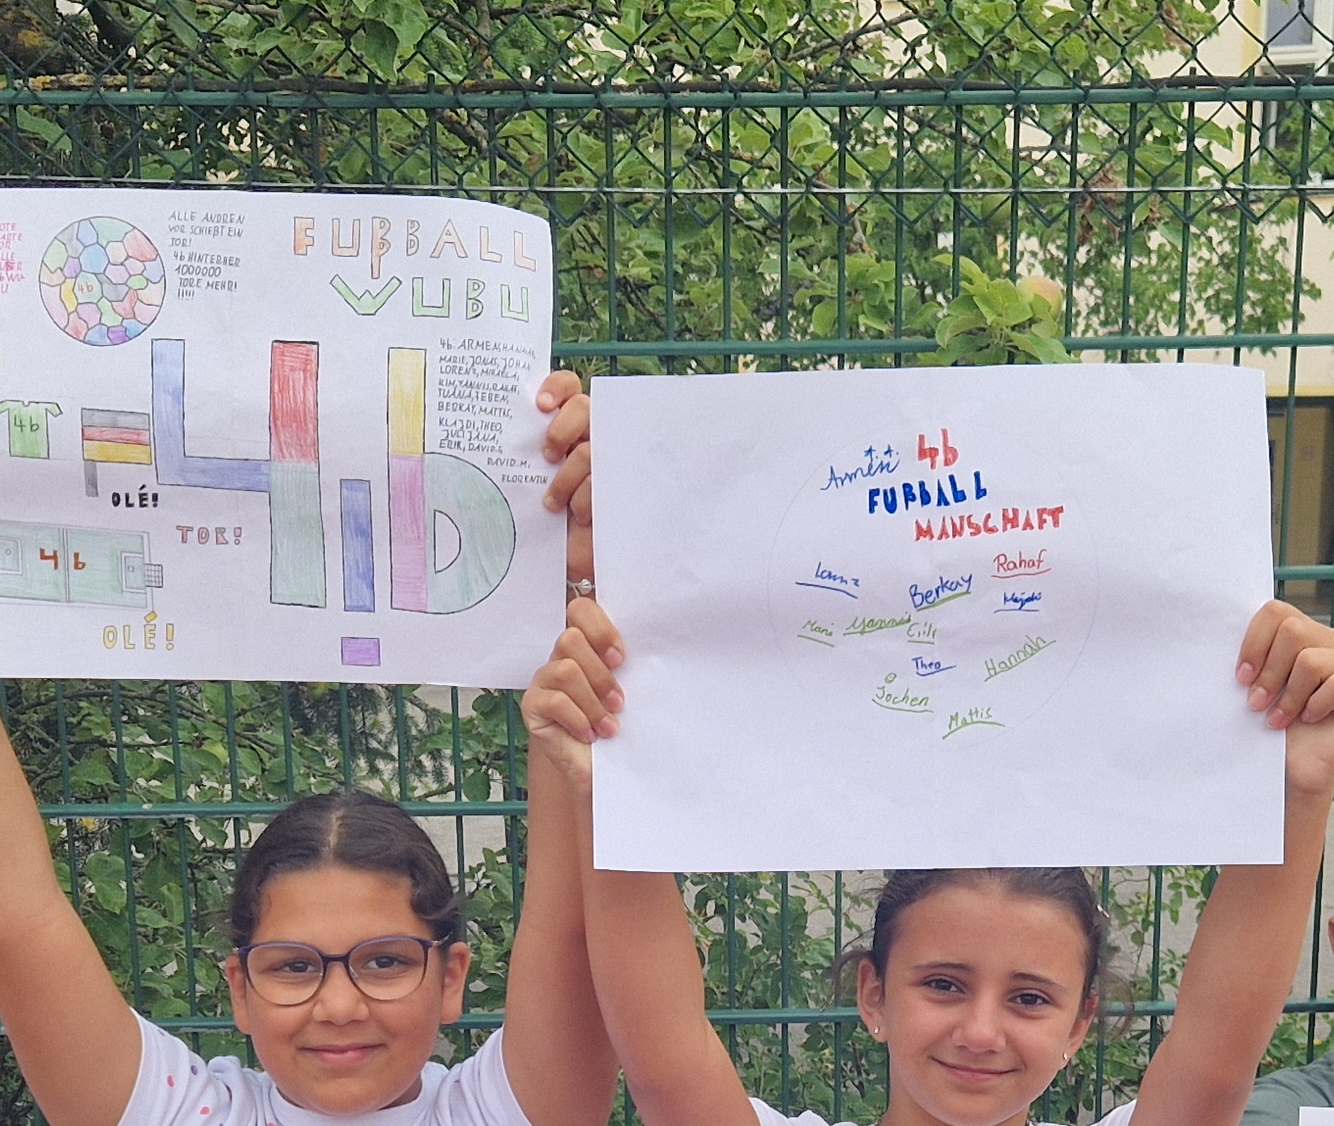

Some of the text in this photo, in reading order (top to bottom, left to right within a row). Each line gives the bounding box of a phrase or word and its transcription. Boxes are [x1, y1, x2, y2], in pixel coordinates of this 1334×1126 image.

[168, 210, 245, 224] ALLE ANDREN
[227, 226, 244, 238] EIN
[173, 250, 185, 261] 4b
[175, 264, 222, 277] 1000000
[77, 280, 94, 294] 4b
[179, 277, 238, 292] TORE MEHR!
[330, 273, 529, 323] WUBU
[14, 416, 40, 433] 4b
[918, 428, 959, 470] 4b
[112, 484, 159, 508] OLÉ!
[915, 506, 1064, 542] MANSCHAFT
[176, 525, 243, 546] TOR!
[993, 549, 1047, 573] Rahaf
[909, 574, 972, 608] Berkay
[103, 610, 175, 651] OLÉ!
[911, 657, 941, 671] Theo
[985, 634, 1046, 679] Hannah
[875, 686, 929, 707] Jochen
[948, 707, 992, 730] Mattis
